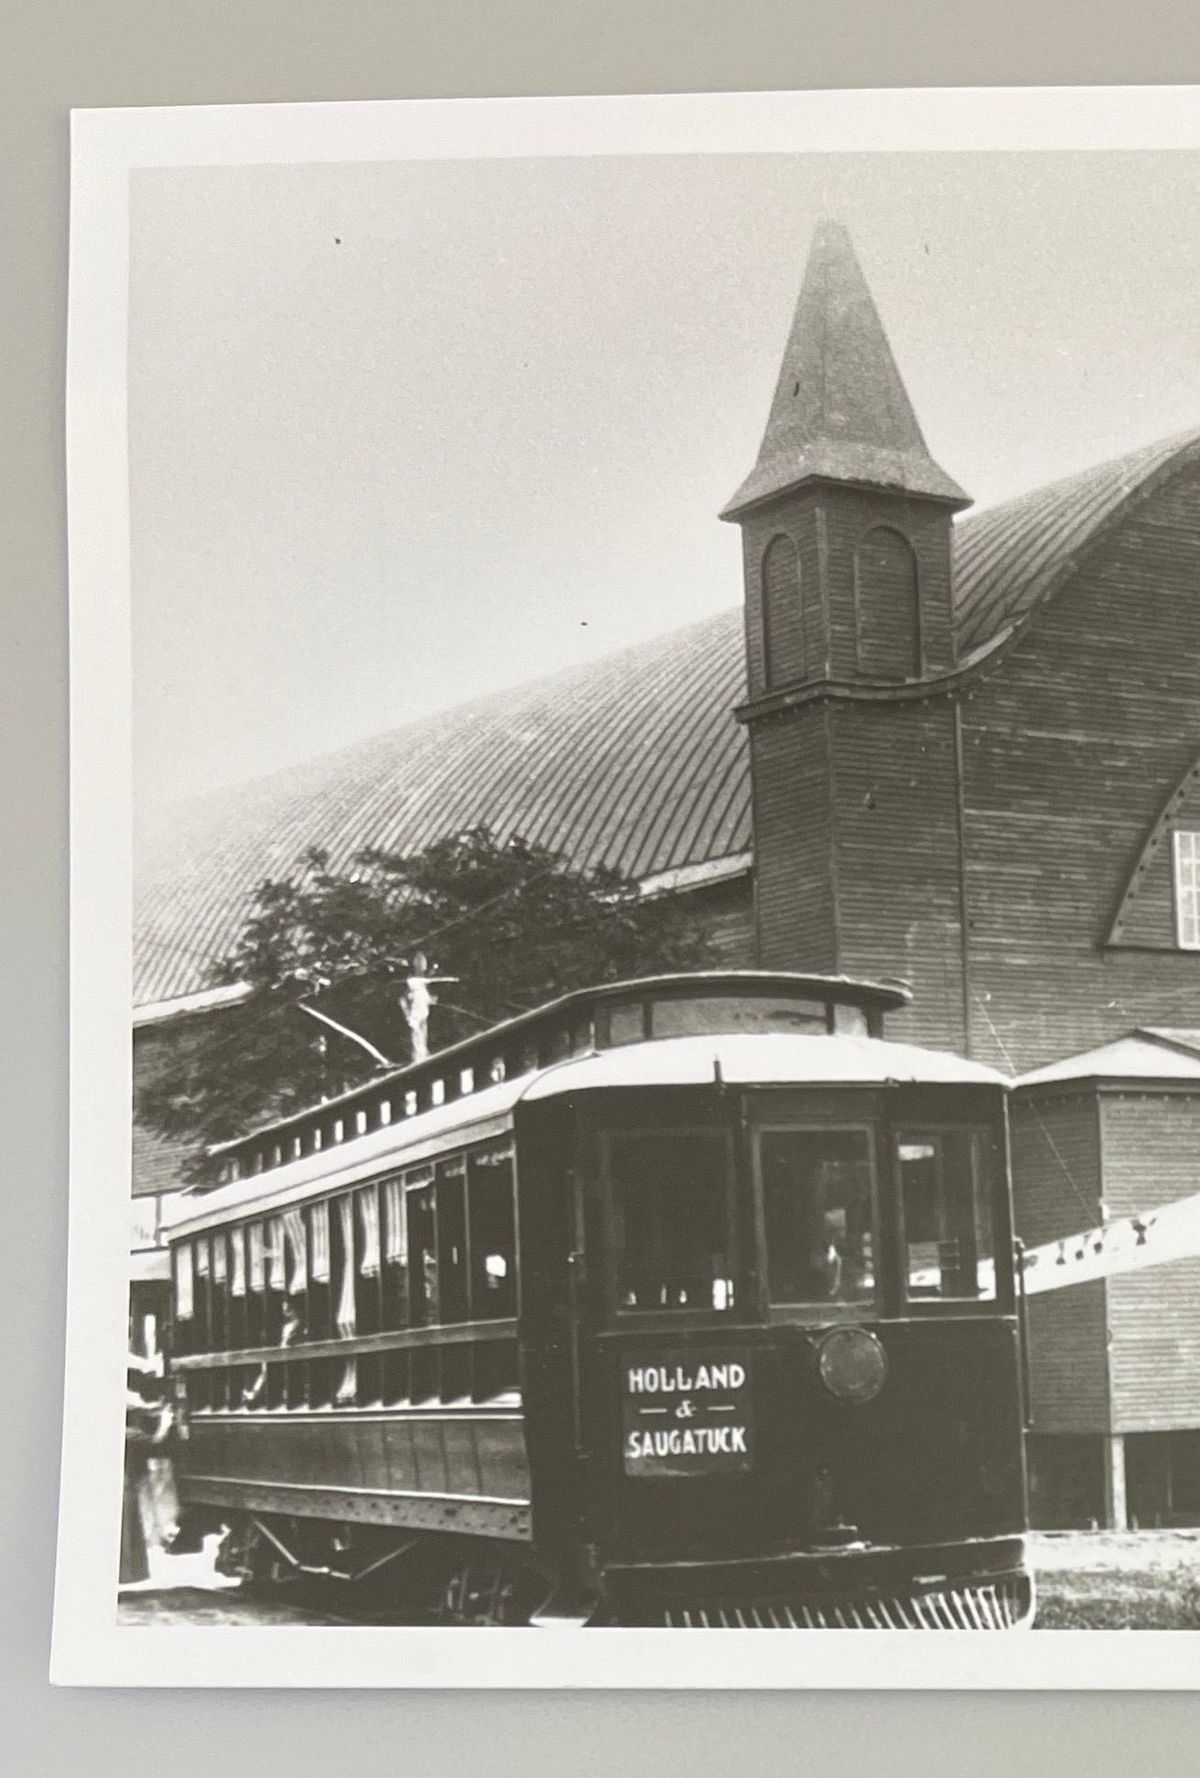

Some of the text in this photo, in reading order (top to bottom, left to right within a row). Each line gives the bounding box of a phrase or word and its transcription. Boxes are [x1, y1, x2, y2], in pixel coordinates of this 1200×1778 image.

[628, 1363, 746, 1393] HOLLAND
[675, 1400, 697, 1418] &
[625, 1426, 747, 1458] SAUGATUCK
